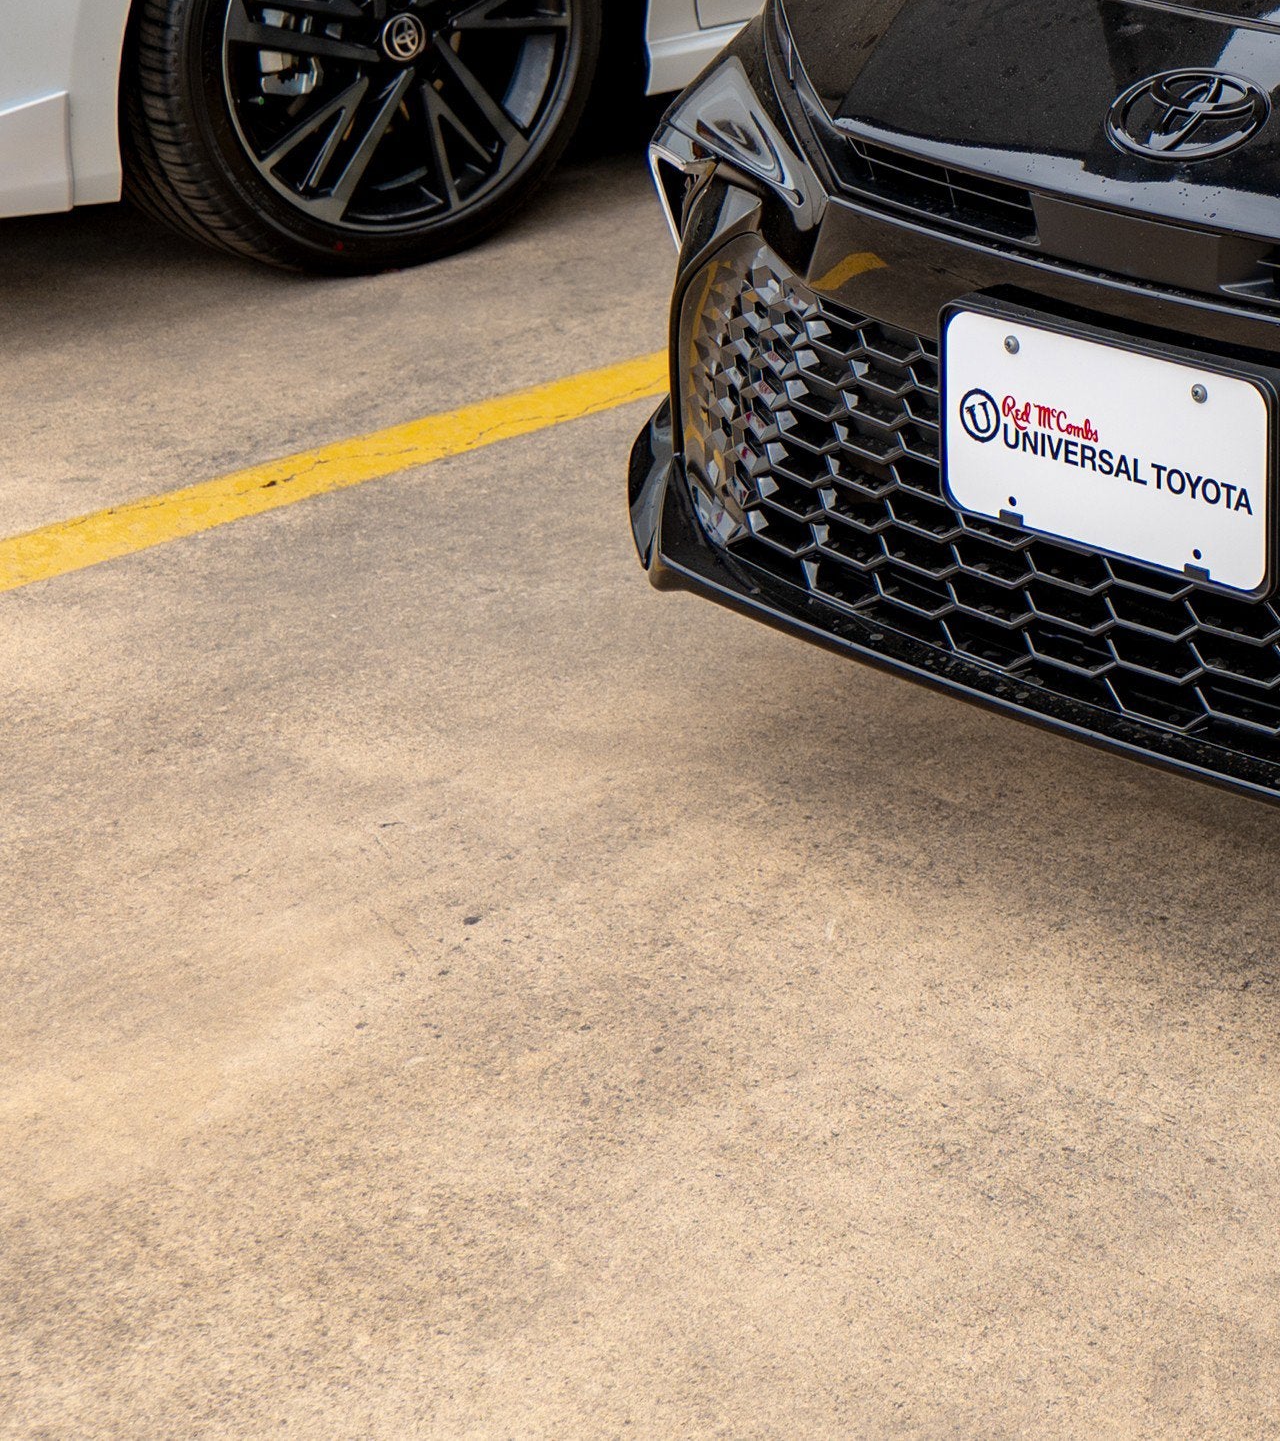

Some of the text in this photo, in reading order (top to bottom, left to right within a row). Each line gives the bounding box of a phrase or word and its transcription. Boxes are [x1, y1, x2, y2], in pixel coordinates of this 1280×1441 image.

[1001, 395, 1099, 443] Red McCombs
[1003, 423, 1254, 516] UNIVERSAL TOYOTA
